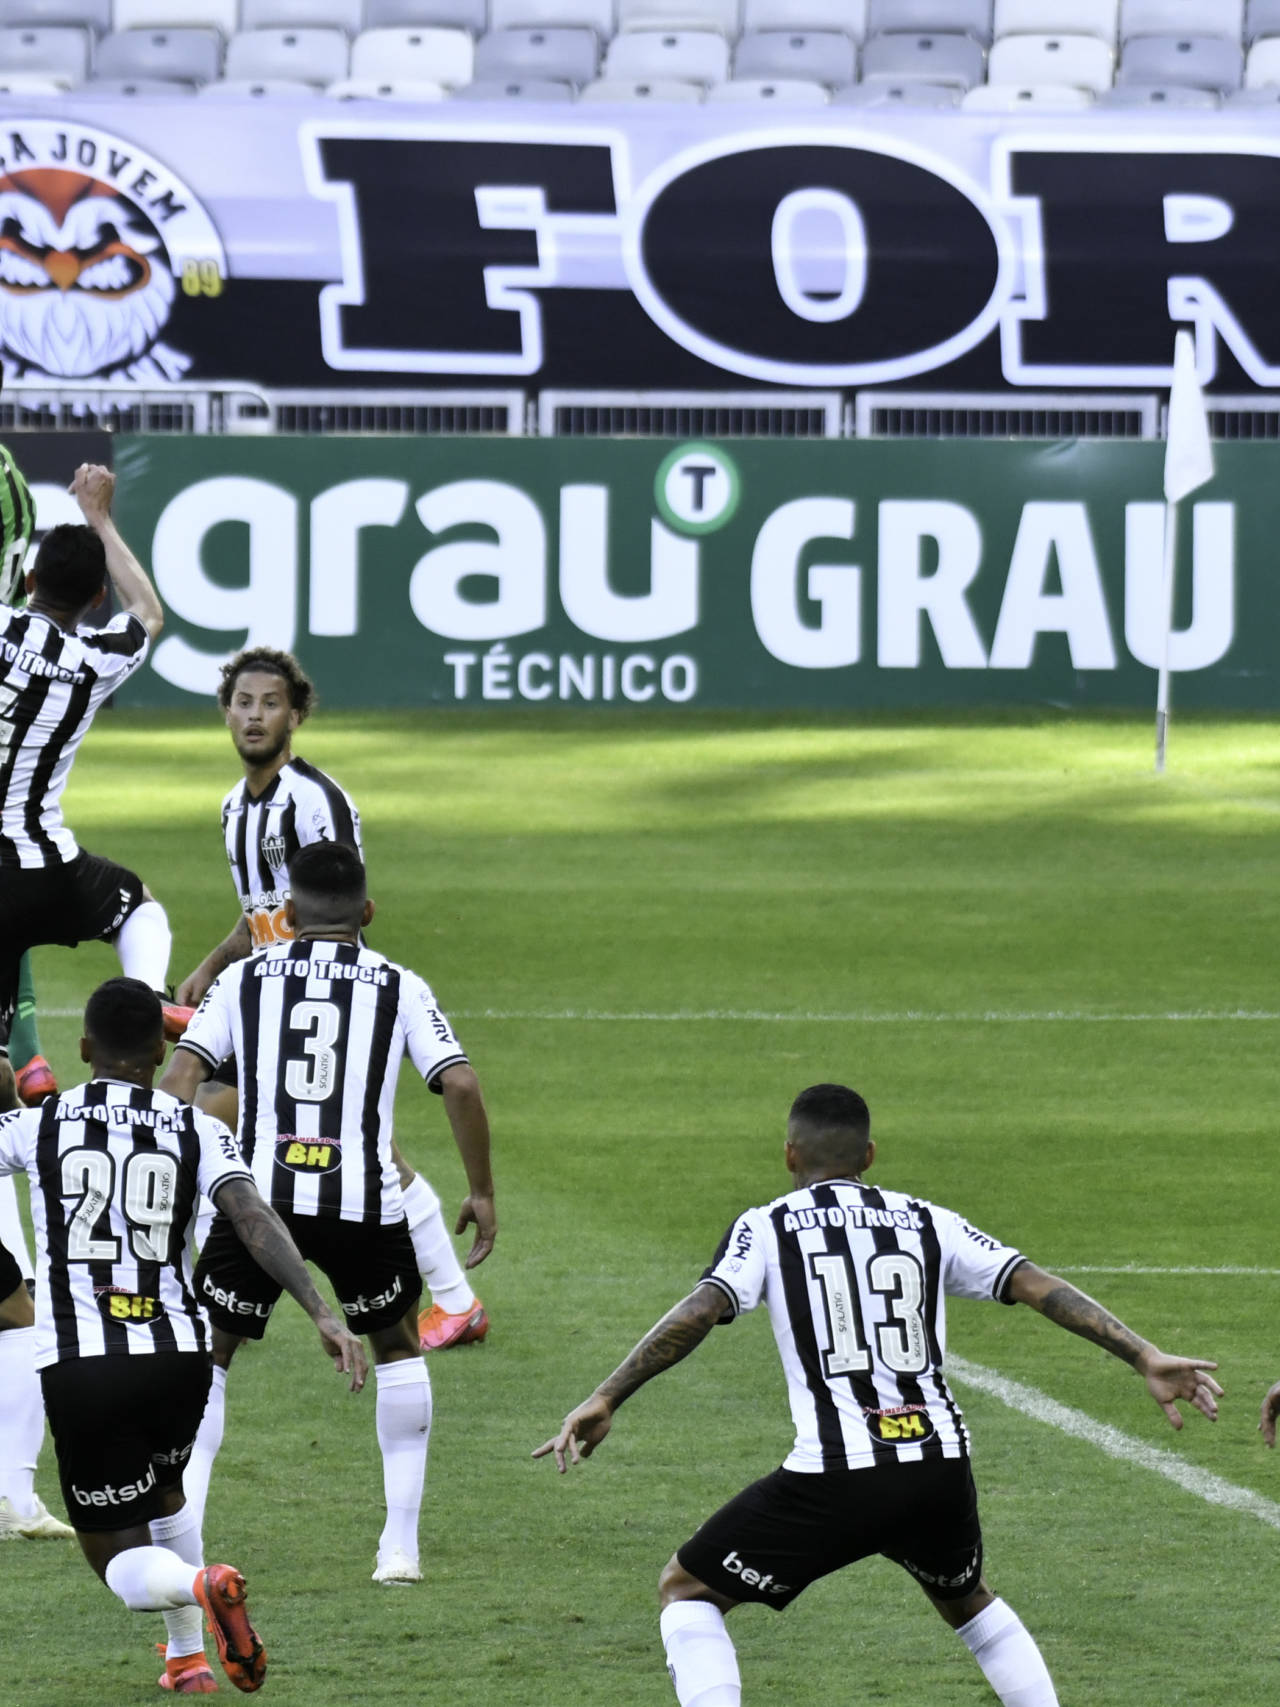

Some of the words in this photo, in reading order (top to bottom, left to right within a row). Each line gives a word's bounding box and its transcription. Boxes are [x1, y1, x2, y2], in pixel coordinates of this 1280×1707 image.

[50, 133, 187, 222] JOVEM
[681, 465, 716, 512] T
[151, 475, 699, 696] grau
[751, 497, 1235, 672] GRAU
[443, 650, 698, 703] TÉCNICO
[253, 958, 310, 978] AUTO
[315, 960, 389, 986] TRUCK
[426, 1008, 454, 1045] MRV
[284, 1001, 341, 1101] 3
[53, 1102, 109, 1123] AUTO
[111, 1103, 187, 1133] TRUCK
[218, 1134, 240, 1164] MRV
[285, 1142, 332, 1168] BH
[60, 1149, 178, 1262] 29
[783, 1206, 845, 1232] AUTO
[850, 1206, 924, 1231] TRUCK
[735, 1221, 754, 1260] MRV
[963, 1227, 1003, 1252] MRV
[110, 1295, 155, 1318] BH
[202, 1273, 274, 1318] betsu
[342, 1274, 403, 1317] etsul
[813, 1254, 928, 1375] 13
[879, 1414, 926, 1439] BH
[71, 1462, 157, 1507] betsul
